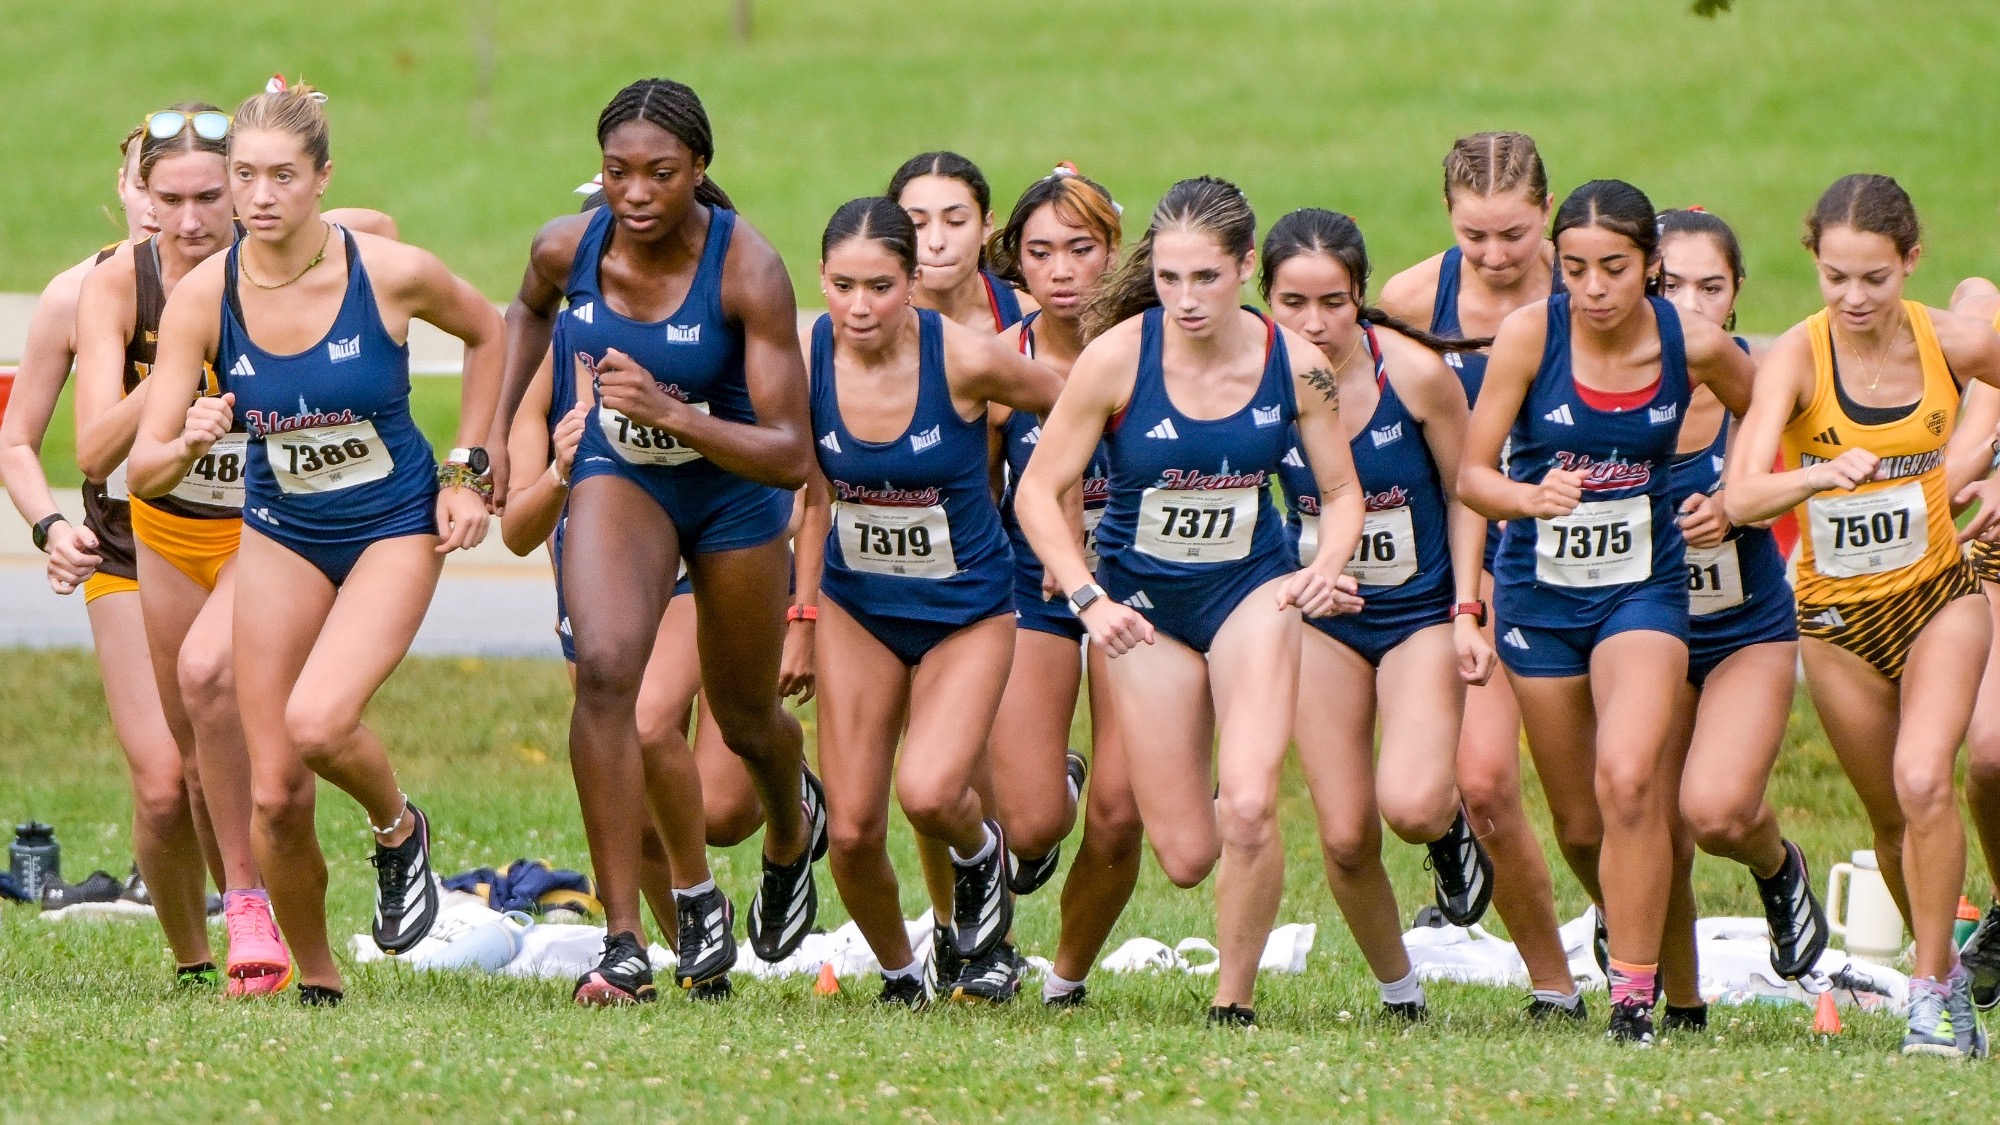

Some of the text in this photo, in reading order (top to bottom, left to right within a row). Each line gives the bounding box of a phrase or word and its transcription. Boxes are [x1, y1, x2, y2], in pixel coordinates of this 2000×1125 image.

[667, 323, 701, 342] VALLEY
[327, 333, 361, 361] VALLEY
[246, 409, 355, 436] Flames
[1251, 403, 1281, 426] VALLEY
[1649, 402, 1677, 423] VALLEY
[614, 415, 679, 450] 738
[910, 424, 942, 452] VALLEY
[1371, 421, 1403, 447] VALLEY
[186, 453, 246, 483] 48
[282, 437, 370, 475] 7386
[1162, 468, 1265, 491] Flames
[1161, 506, 1237, 538] 7377
[1828, 507, 1910, 549] 7507
[854, 522, 932, 557] 7379
[1552, 521, 1633, 559] 7375
[1688, 563, 1722, 591] 81
